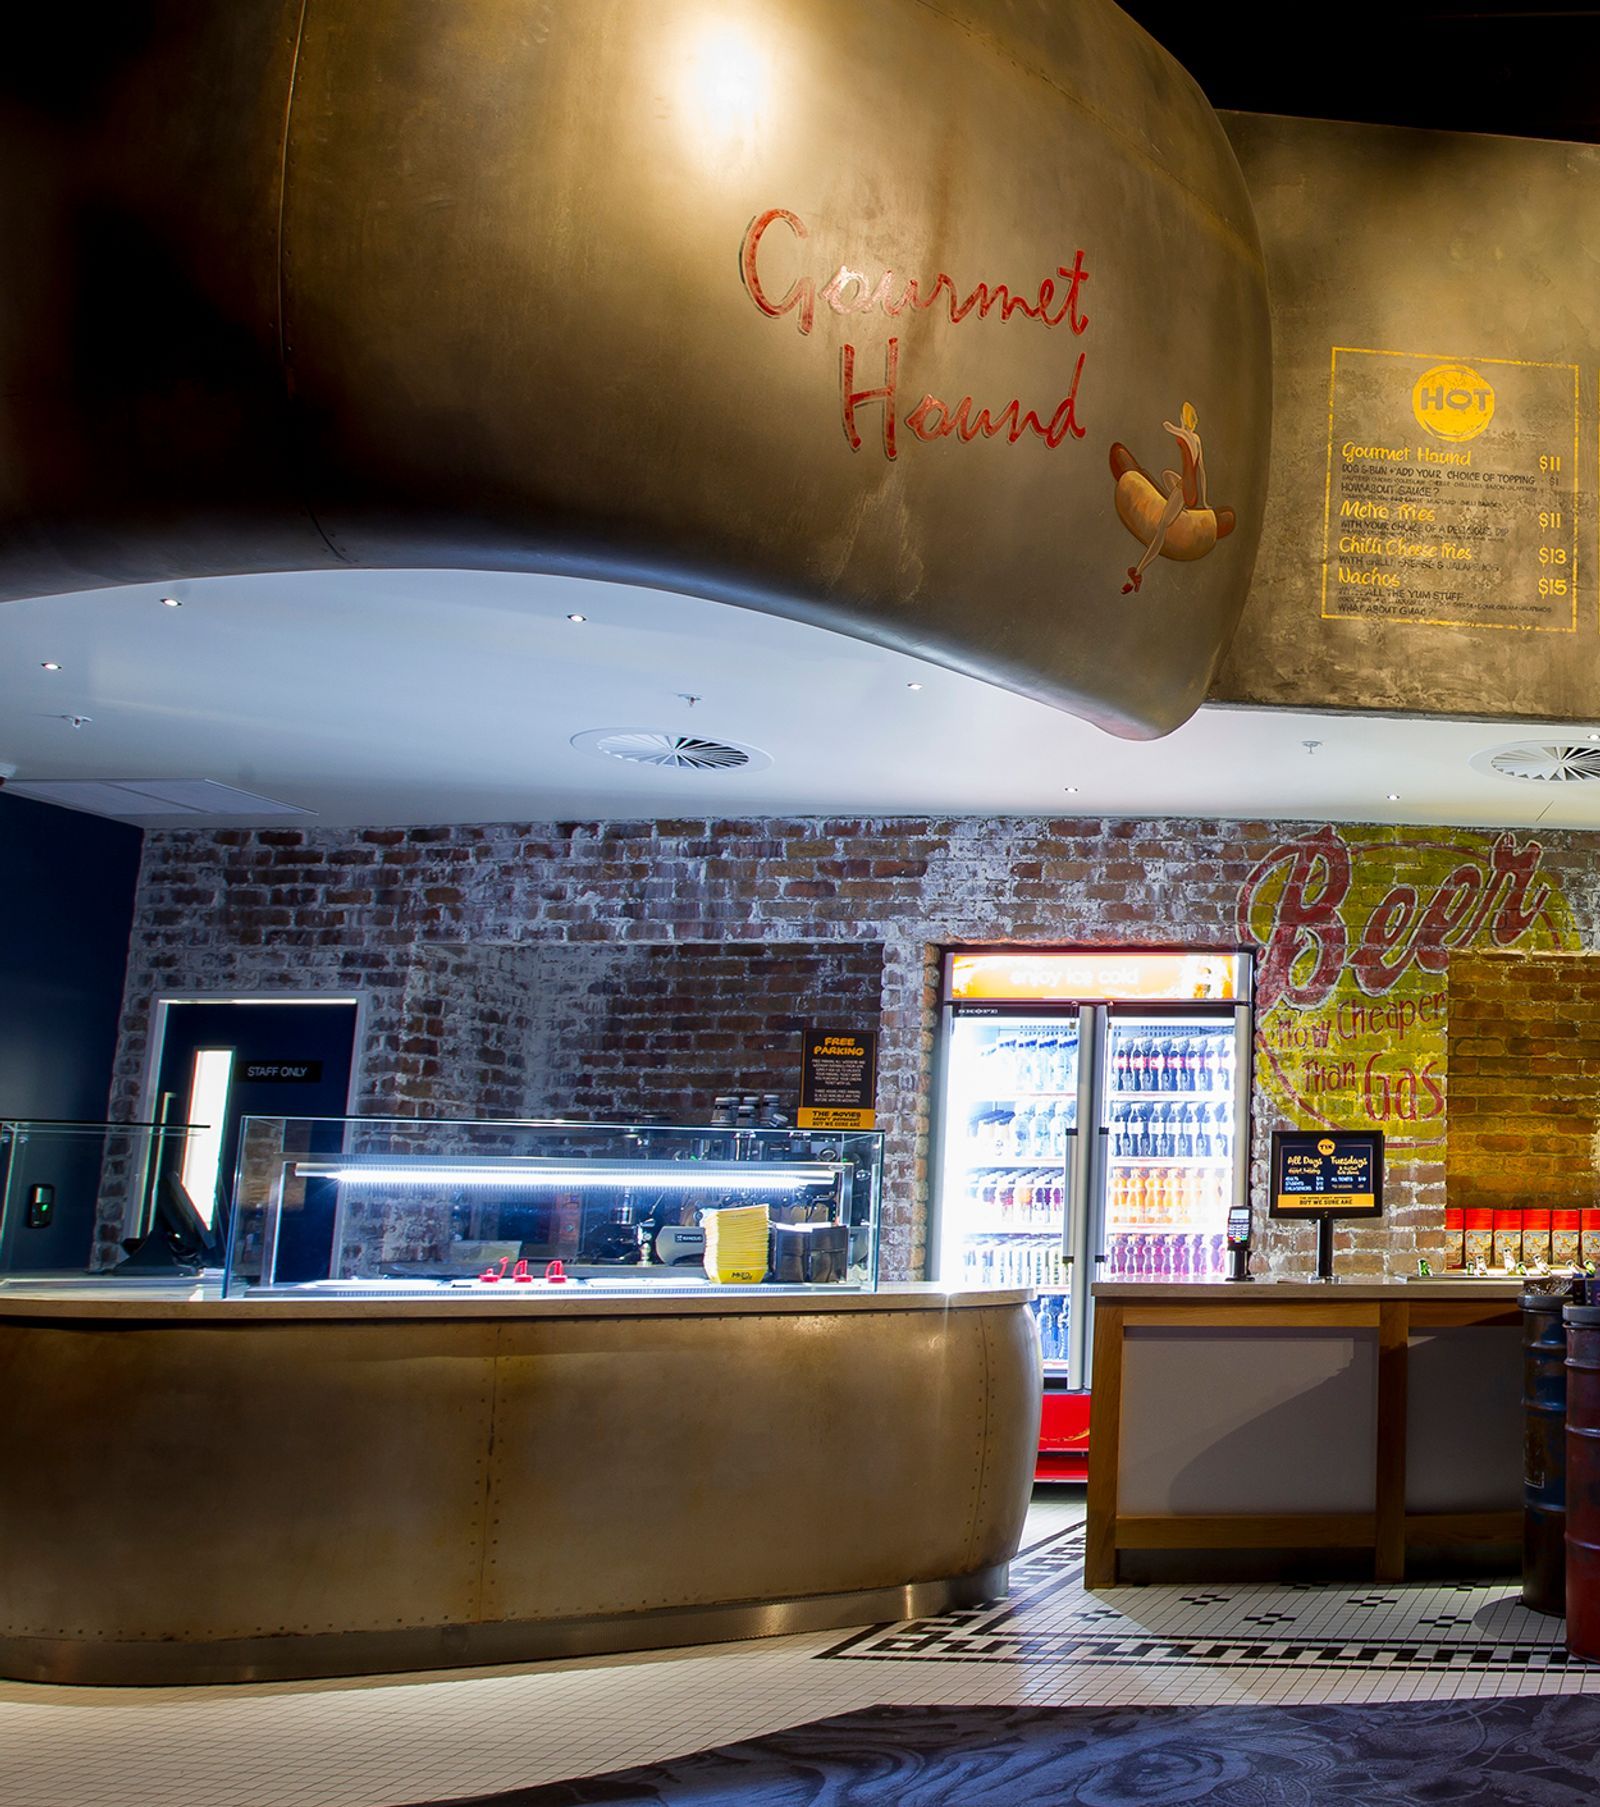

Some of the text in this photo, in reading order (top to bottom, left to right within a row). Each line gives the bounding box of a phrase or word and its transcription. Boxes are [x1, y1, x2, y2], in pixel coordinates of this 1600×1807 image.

[740, 207, 1090, 336] Gourmet
[840, 337, 1087, 462] Hound
[1420, 386, 1491, 411] HOT
[1342, 441, 1561, 473] Gourmet Hound $11
[1342, 464, 1359, 473] DOG
[1369, 465, 1387, 475] BUN
[1396, 467, 1414, 477] ADD
[1416, 468, 1442, 479] YOUR
[1447, 471, 1480, 481] CHOICE
[1482, 473, 1495, 482] OF
[1497, 474, 1535, 485] TOPPING
[1340, 500, 1390, 520] Metro
[1538, 511, 1561, 531] $11
[1425, 524, 1436, 533] OF
[1339, 535, 1381, 555] Chilli
[1386, 537, 1438, 557] Cheese
[1538, 544, 1567, 567] $13
[1338, 567, 1567, 599] Nachos $15
[1408, 589, 1431, 599] YUM
[1432, 591, 1464, 600] STUFF
[1365, 604, 1397, 614] ABOUT
[1236, 824, 1551, 1009] Beer
[1099, 966, 1139, 984] cold
[813, 1046, 866, 1056] PARKING
[824, 1037, 855, 1046] FREE
[247, 1066, 308, 1077] STAFF ONLY
[1364, 1052, 1443, 1122] Gas
[1287, 1155, 1323, 1168] All Days
[1330, 1155, 1368, 1168] Tuesdays
